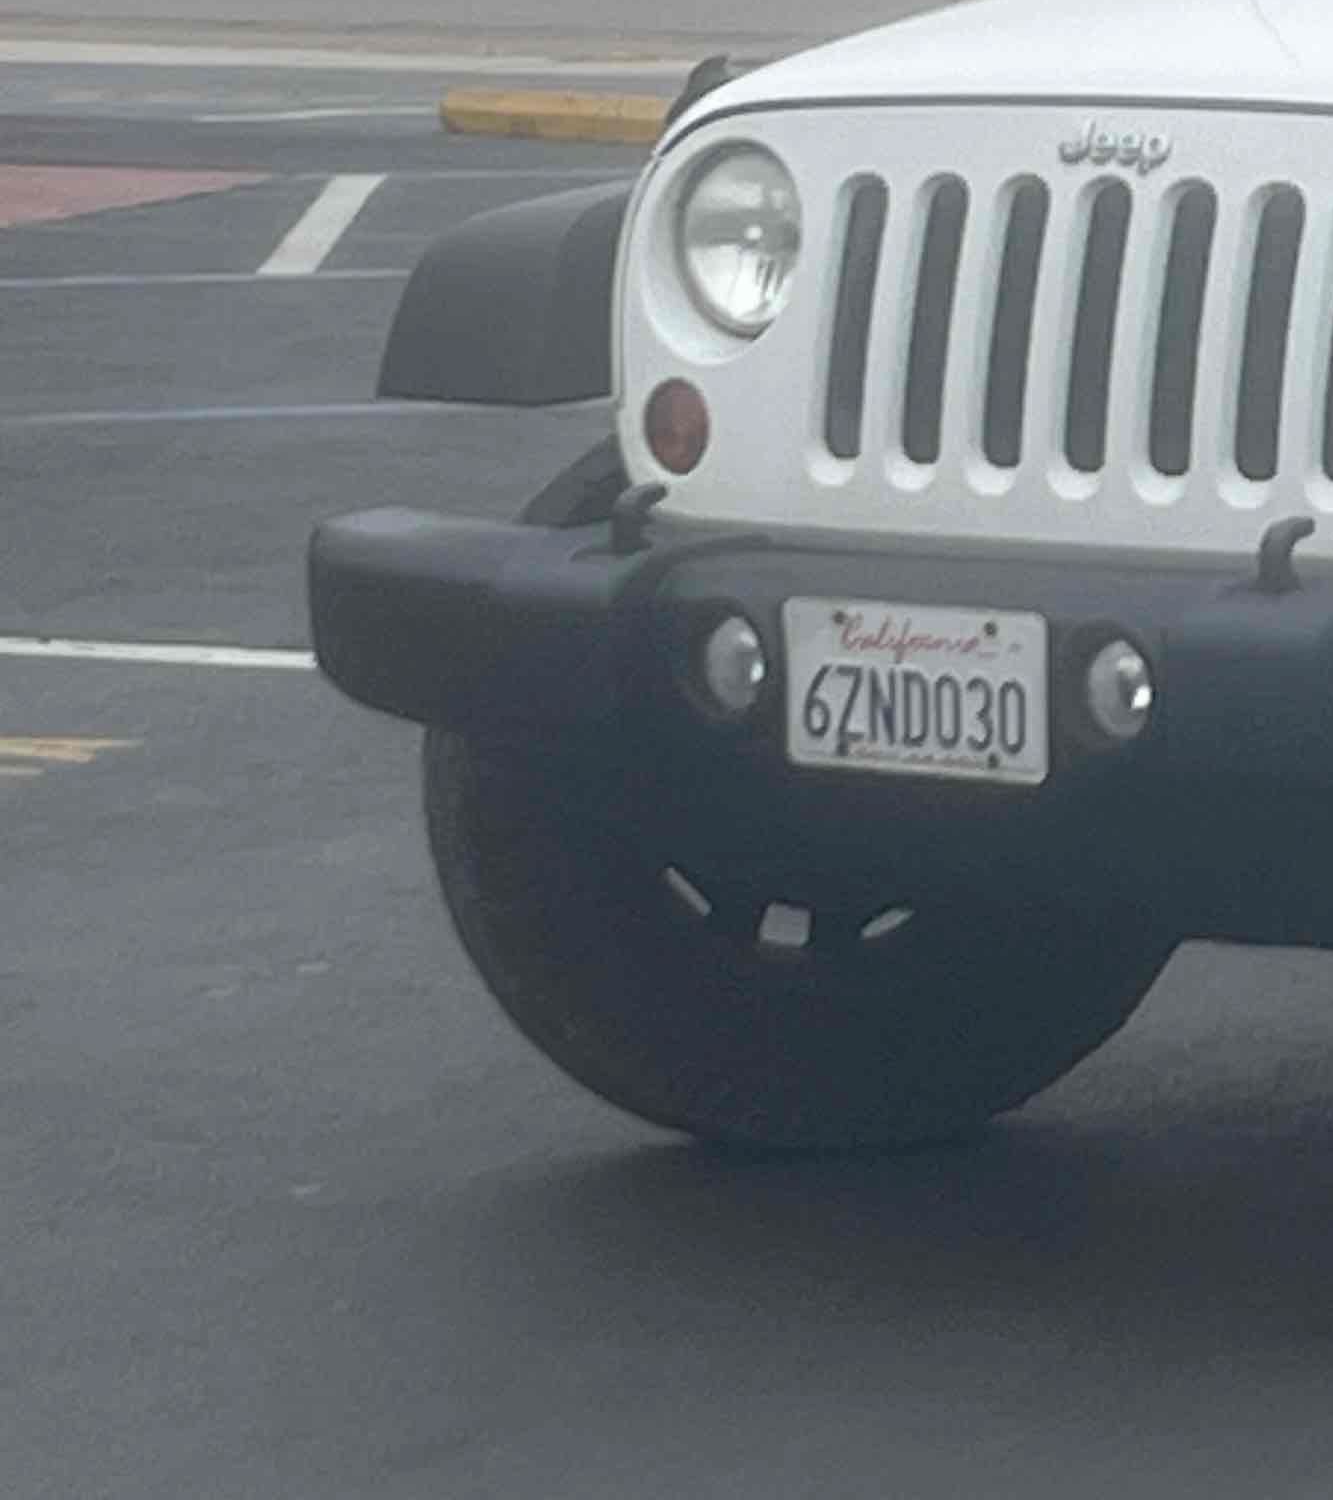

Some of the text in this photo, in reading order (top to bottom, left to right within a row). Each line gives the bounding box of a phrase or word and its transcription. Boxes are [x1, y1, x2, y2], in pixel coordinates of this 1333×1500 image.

[1058, 117, 1173, 177] Jeep
[840, 612, 982, 663] California
[803, 663, 1027, 756] 6ZND030
